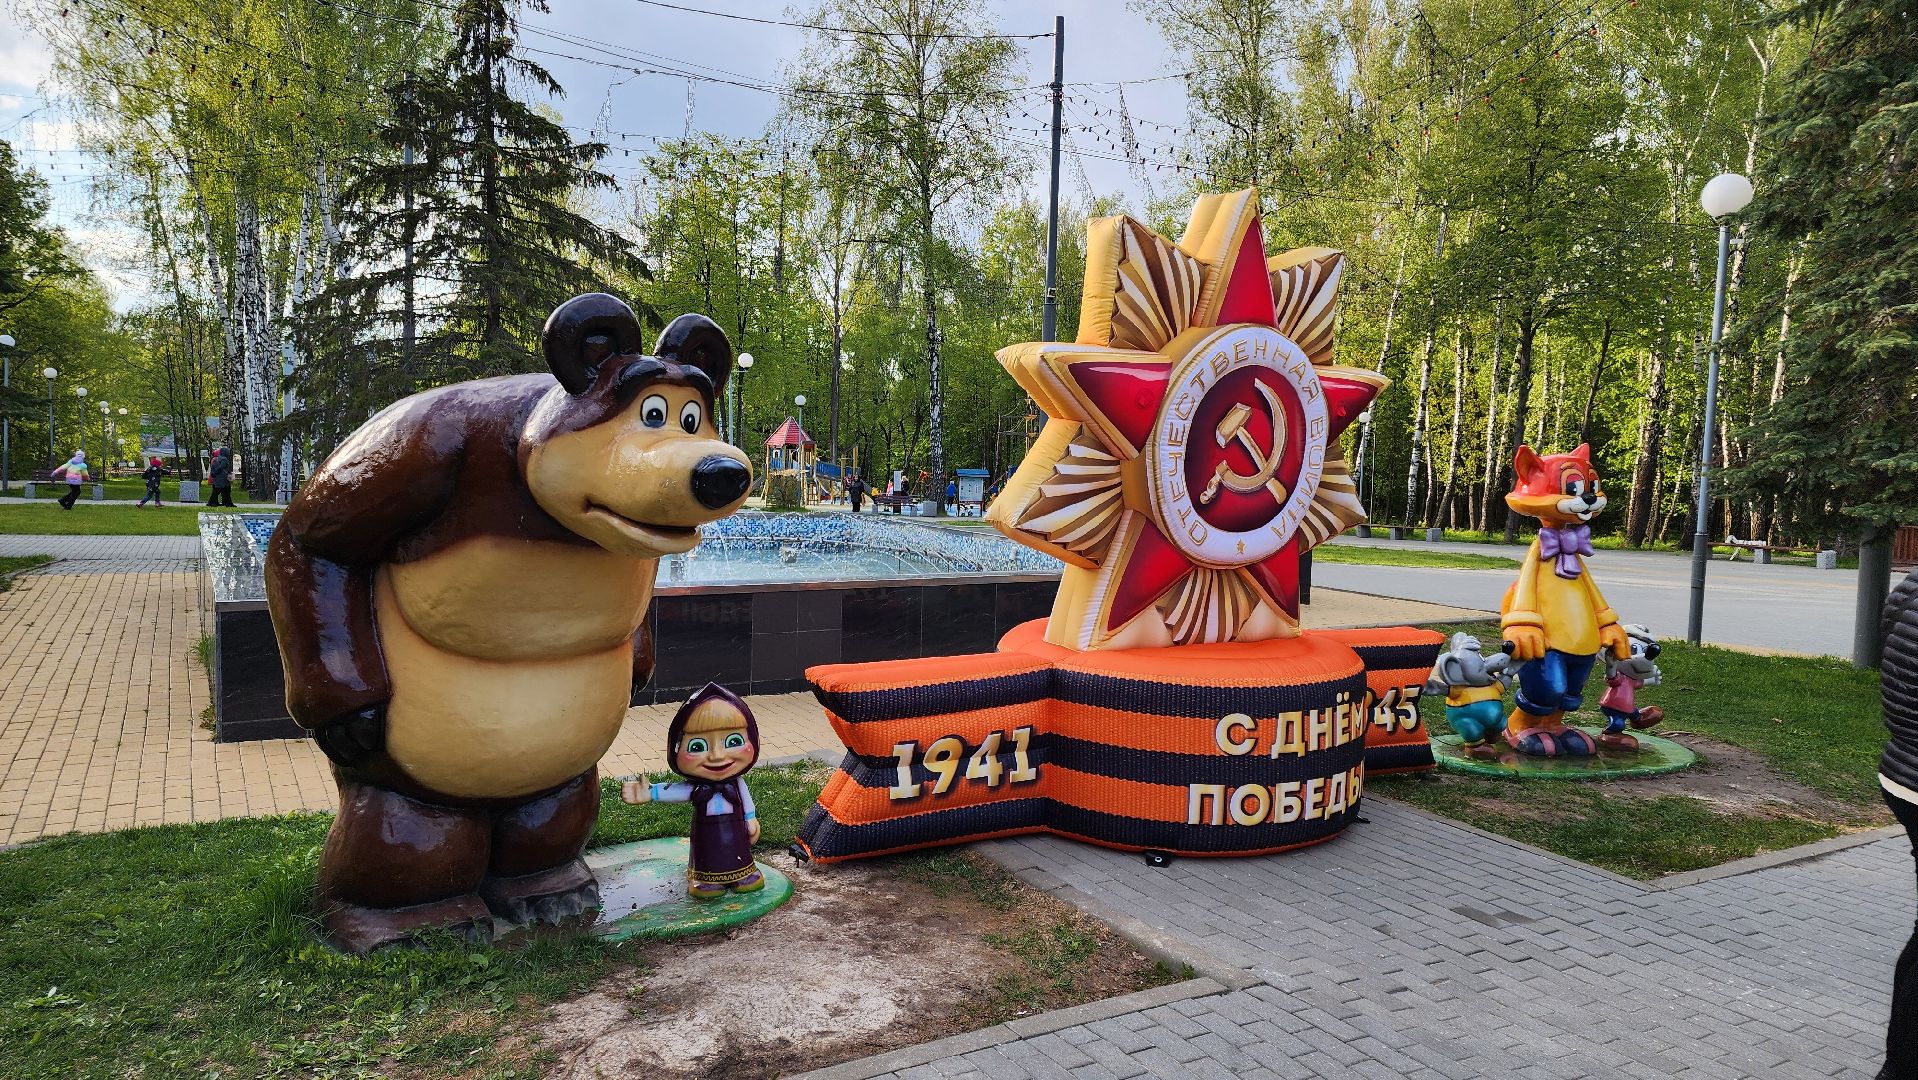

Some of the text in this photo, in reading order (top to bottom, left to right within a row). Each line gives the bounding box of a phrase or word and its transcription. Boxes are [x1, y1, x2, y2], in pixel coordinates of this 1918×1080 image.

[1167, 338, 1320, 546] ОТЕЧЕСТВЕННАЯ
[1215, 691, 1364, 760] С ДНЁМ
[1365, 687, 1421, 732] 45
[889, 727, 1037, 800] 1941
